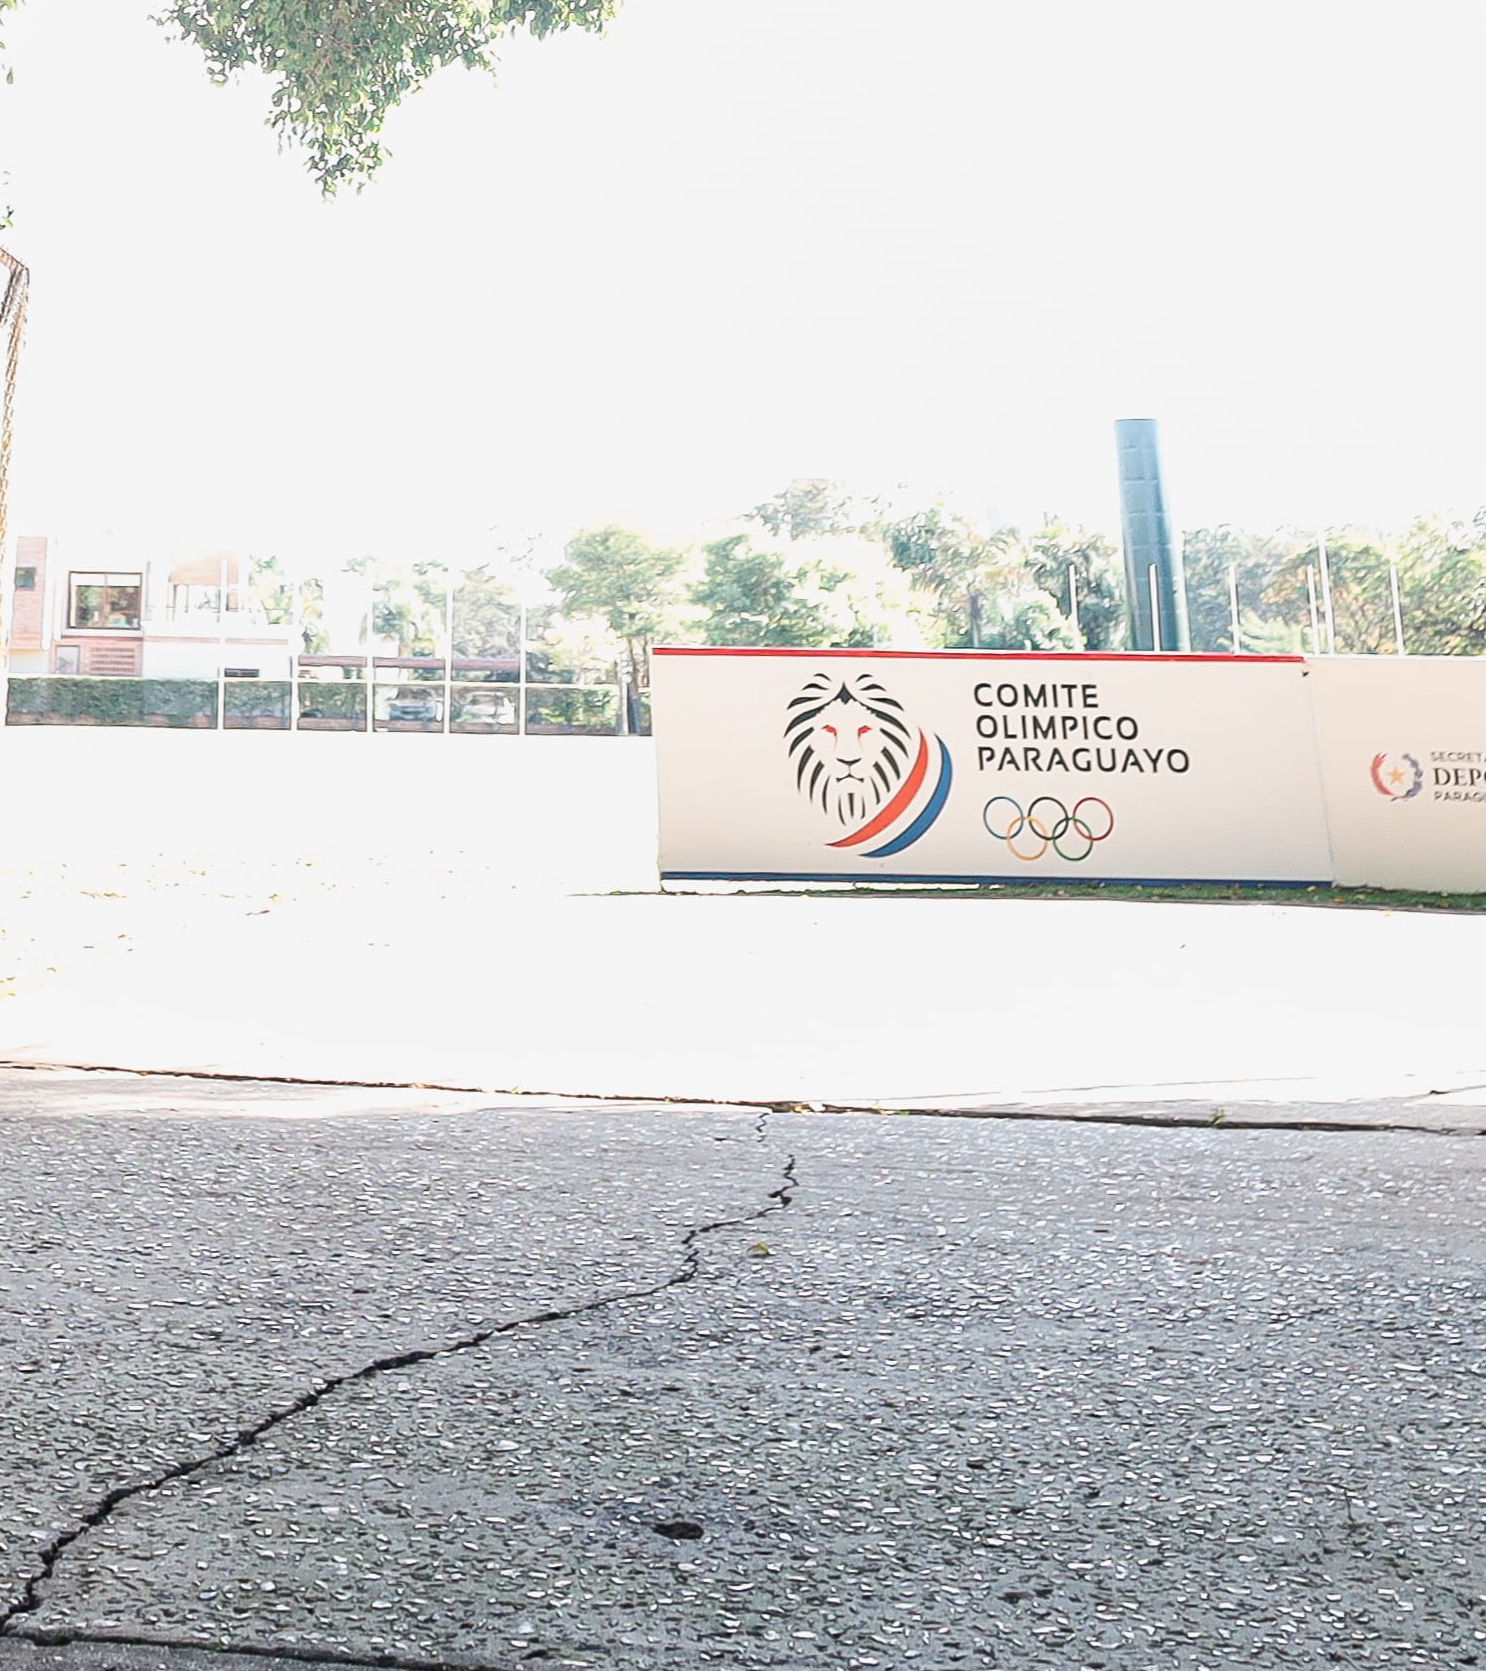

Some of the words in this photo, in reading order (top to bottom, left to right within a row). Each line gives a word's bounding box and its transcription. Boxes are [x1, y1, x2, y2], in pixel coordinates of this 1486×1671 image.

[973, 682, 1100, 709] COMITE
[975, 714, 1139, 741] OLIMPICO
[977, 745, 1190, 774] PARAGUAYO
